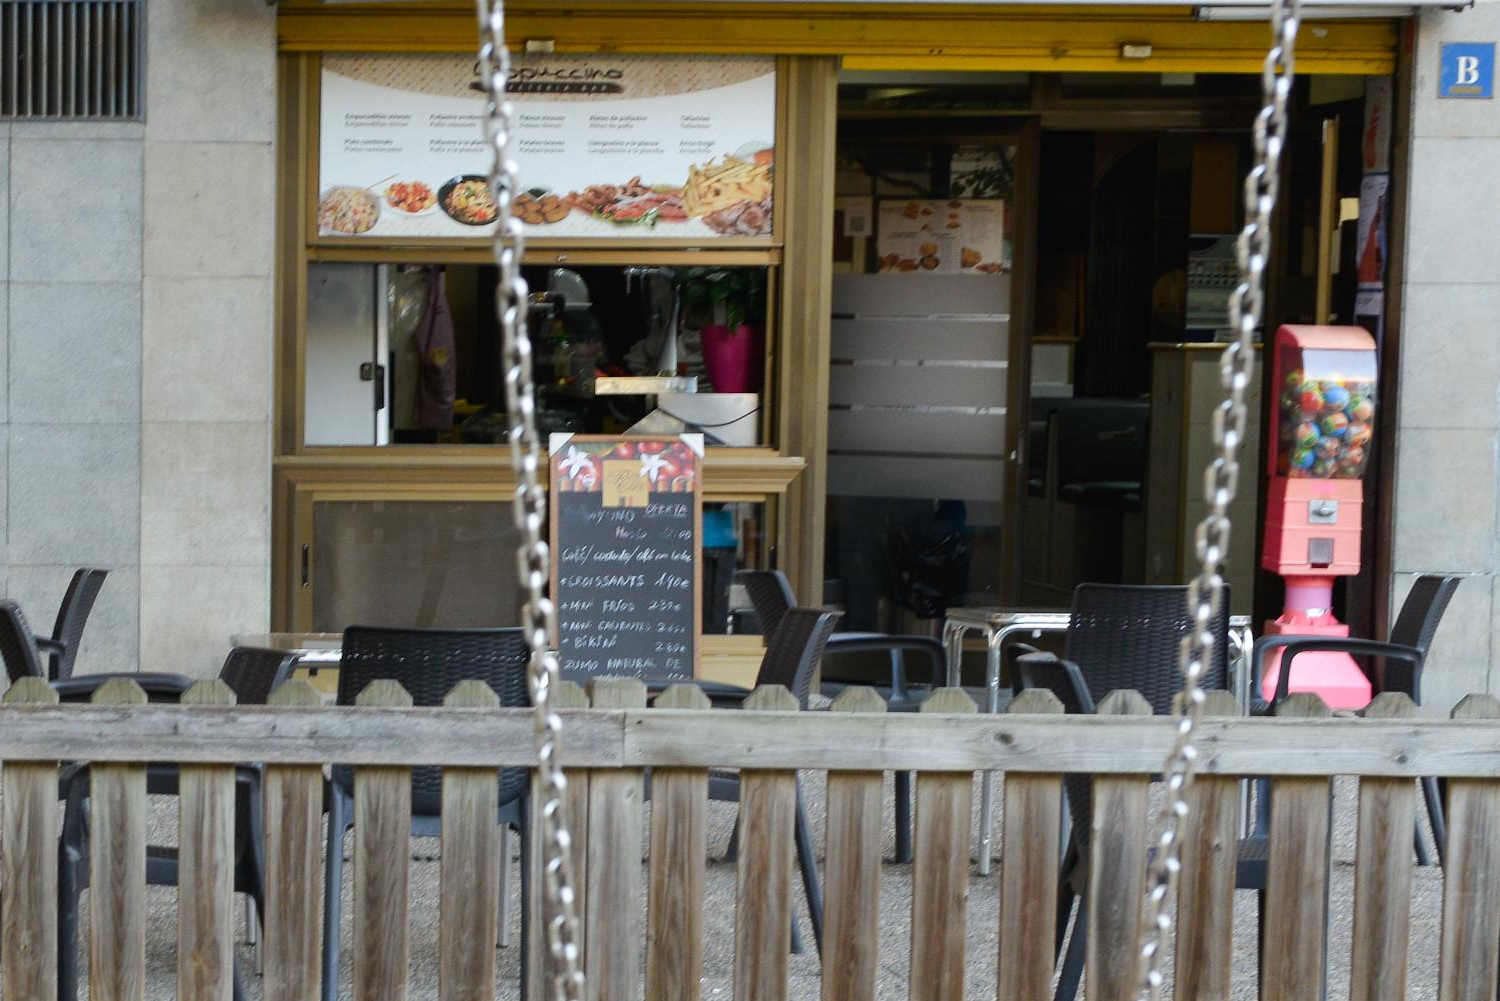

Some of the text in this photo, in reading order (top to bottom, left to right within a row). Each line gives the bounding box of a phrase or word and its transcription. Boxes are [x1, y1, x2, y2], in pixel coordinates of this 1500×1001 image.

[473, 61, 623, 83] Cppuccino
[1456, 56, 1479, 85] B
[564, 658, 598, 672] ZUMO
[607, 658, 656, 670] NATURAL
